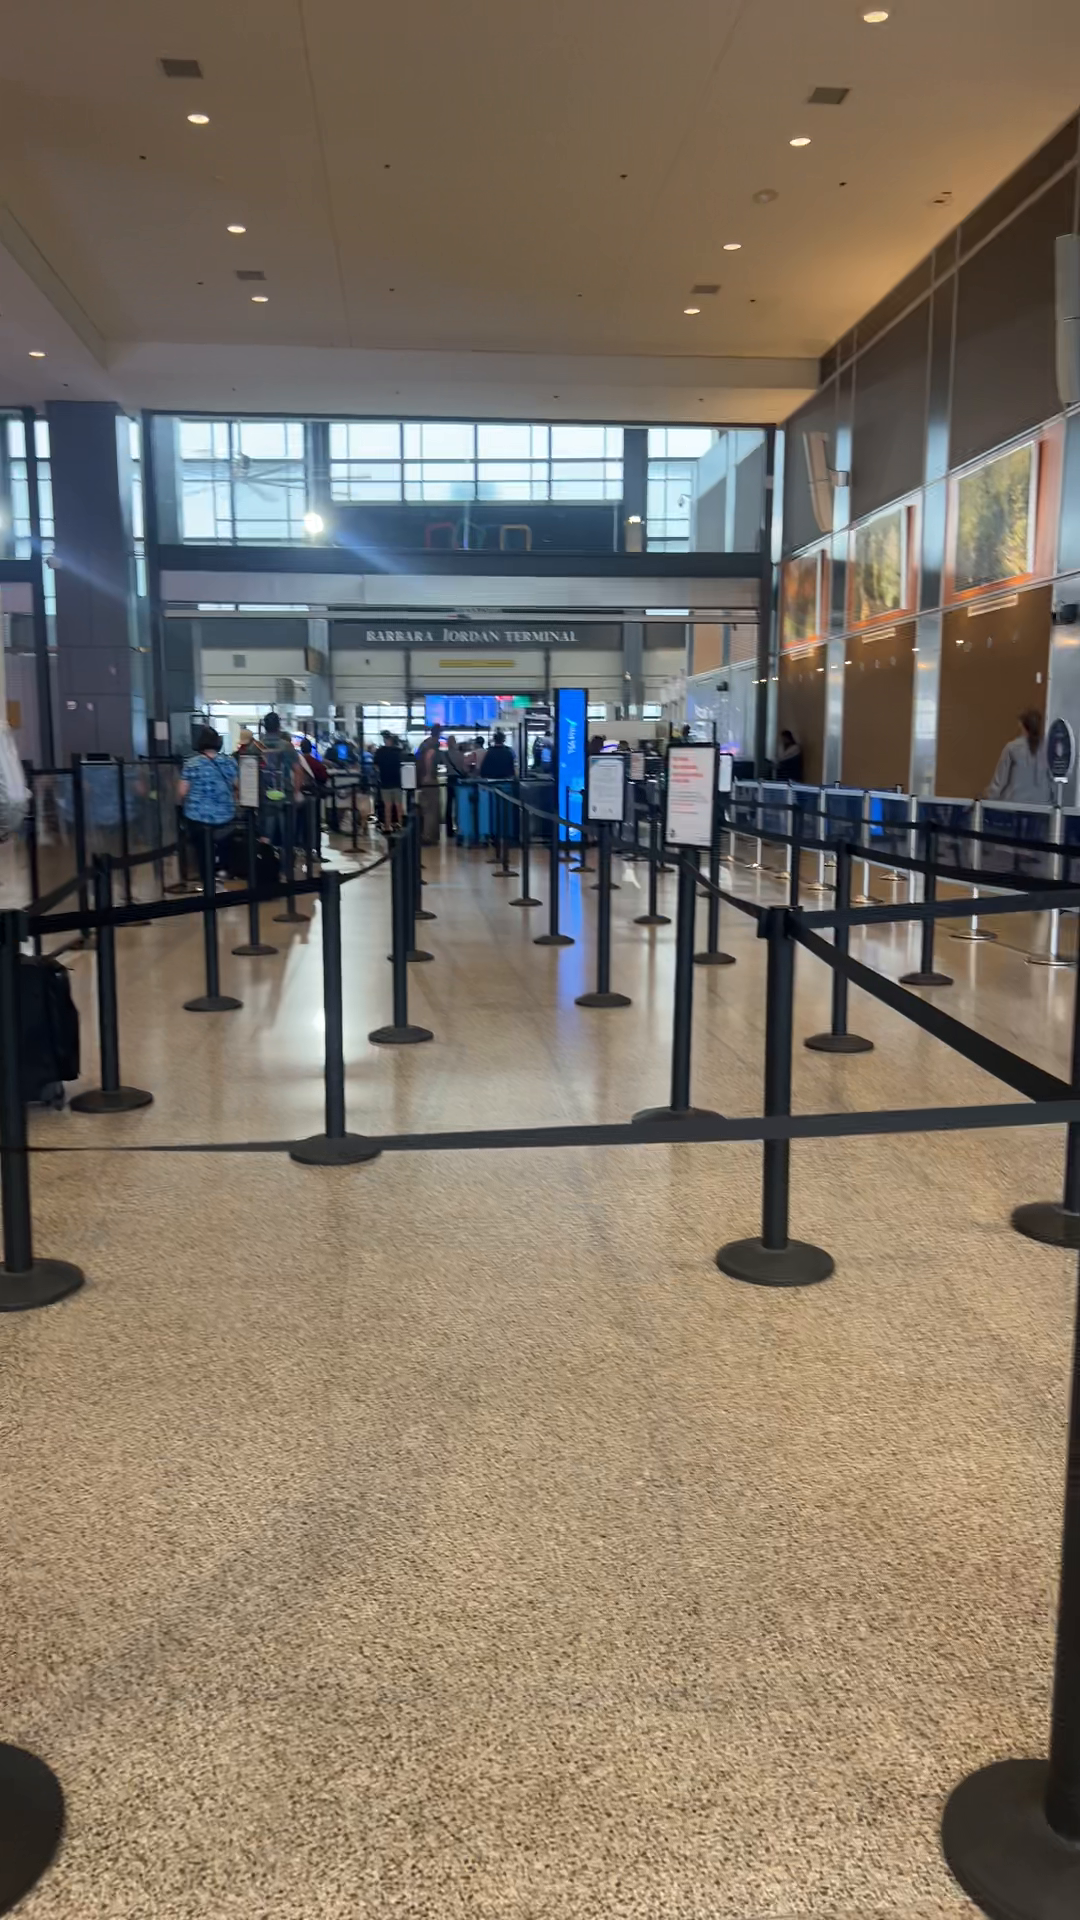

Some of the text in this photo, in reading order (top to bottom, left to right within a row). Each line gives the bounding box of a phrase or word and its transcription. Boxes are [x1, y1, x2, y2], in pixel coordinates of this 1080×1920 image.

[366, 628, 579, 642] BARBARA JORDAN TERMINAL
